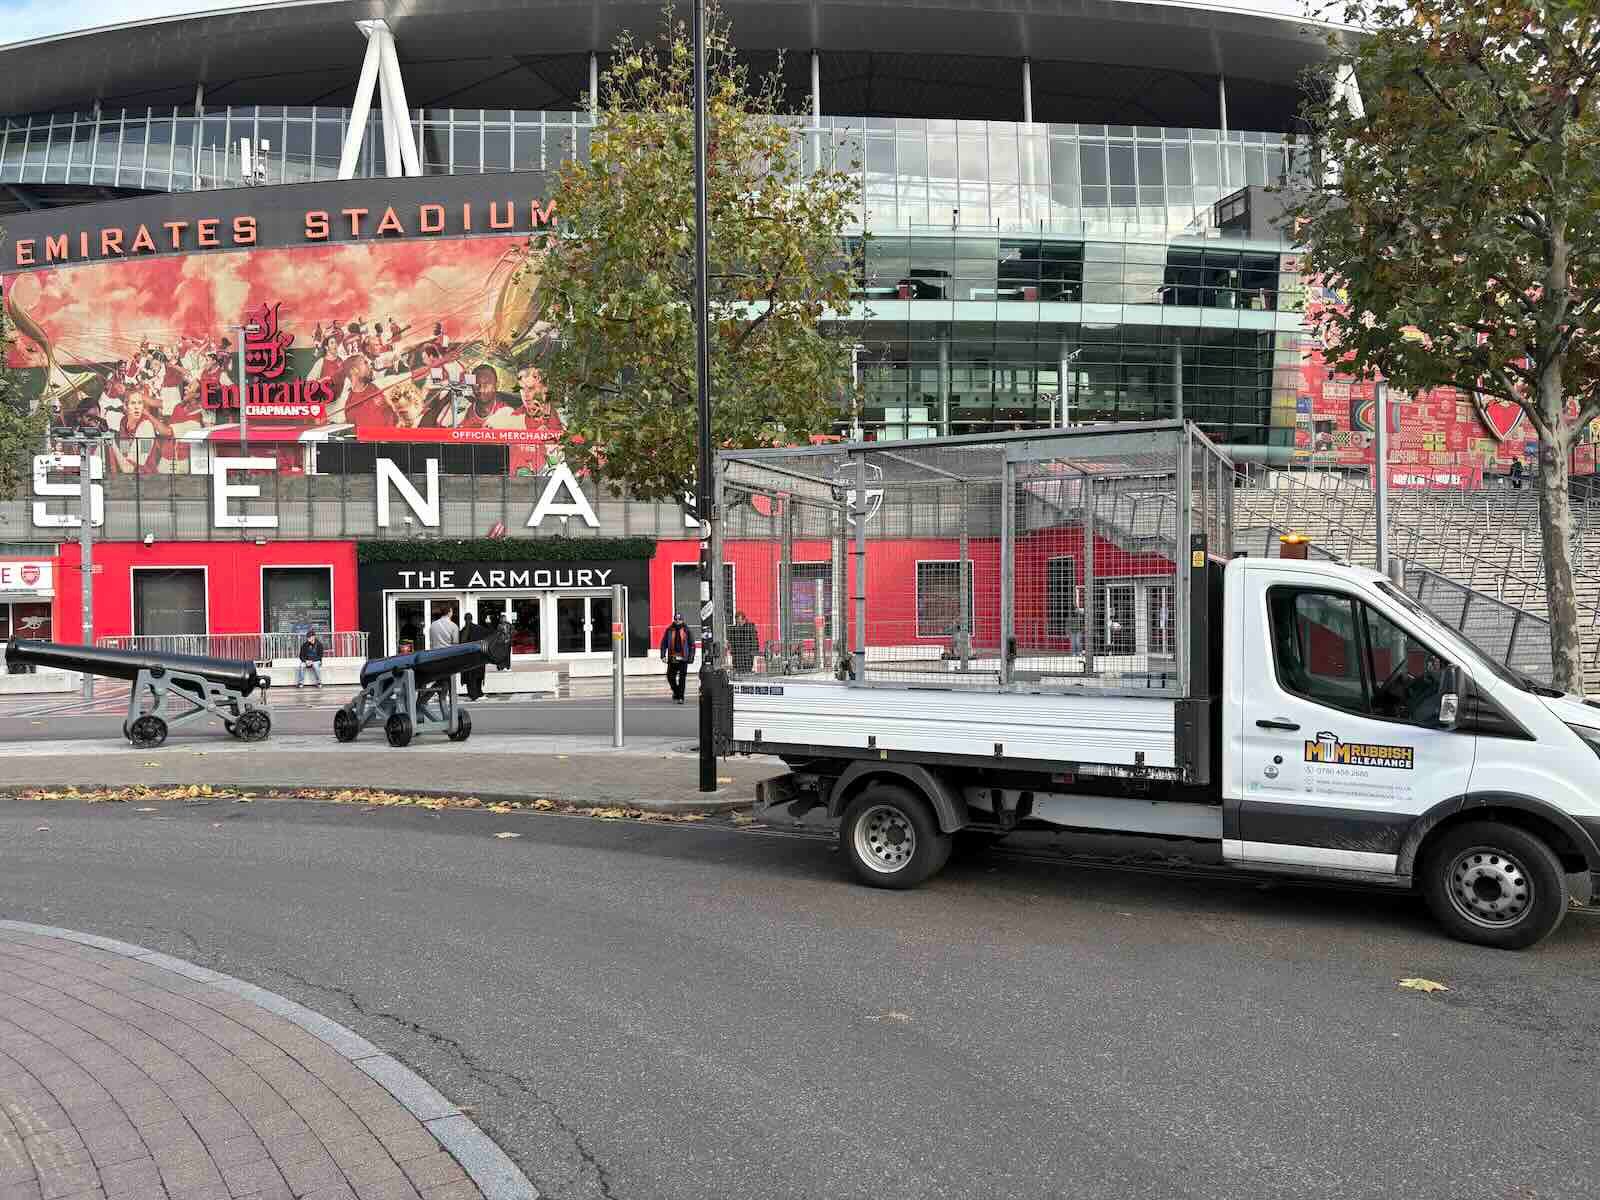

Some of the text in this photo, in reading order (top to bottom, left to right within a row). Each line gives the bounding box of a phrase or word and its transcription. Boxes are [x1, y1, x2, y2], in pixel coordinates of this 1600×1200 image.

[16, 199, 559, 265] EMIRATES STADIUM
[201, 376, 335, 409] Emirates
[245, 404, 310, 417] CHAPMAN'S
[452, 430, 497, 440] OFFICIAL
[398, 568, 613, 589] THE ARMOURY
[1351, 744, 1412, 761] RUBBISH
[1351, 756, 1412, 769] CLEARANCE
